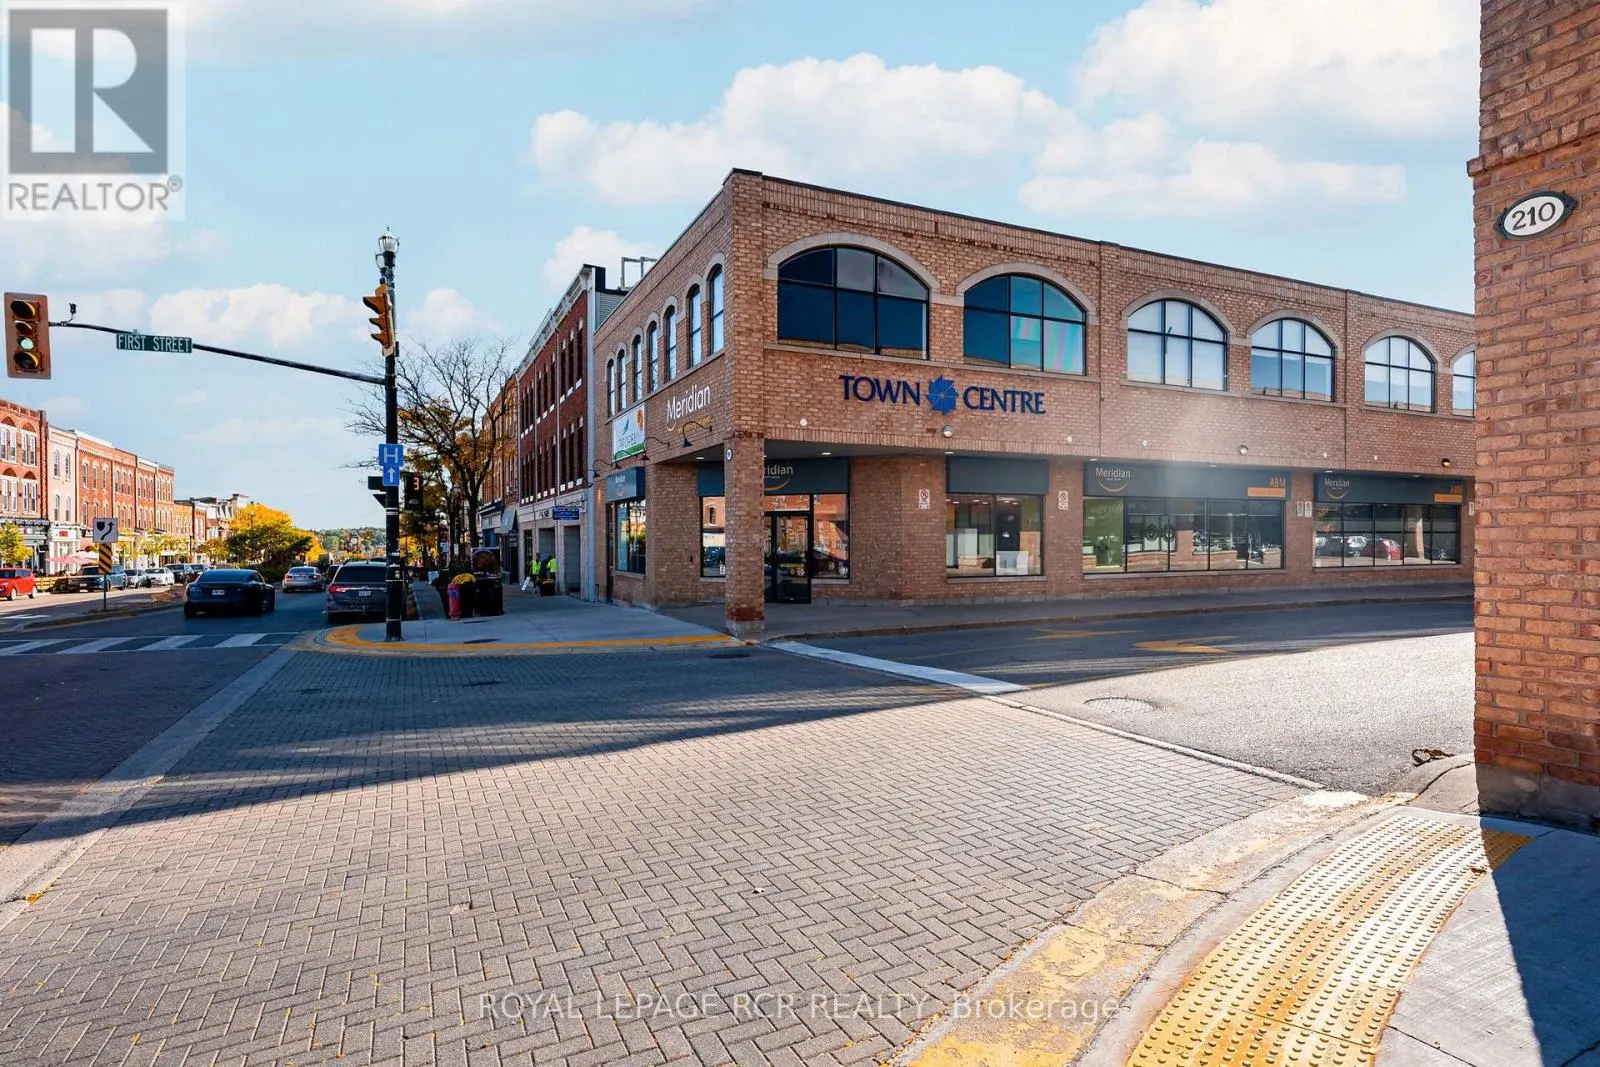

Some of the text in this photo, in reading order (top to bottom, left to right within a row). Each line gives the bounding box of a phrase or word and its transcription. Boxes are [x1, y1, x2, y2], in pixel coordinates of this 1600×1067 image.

[1511, 202, 1556, 231] 210
[118, 334, 190, 353] FIRST STREET
[666, 384, 711, 423] Meridian
[838, 374, 1046, 415] TOWN CENTRE
[383, 446, 398, 464] H
[1095, 467, 1131, 479] Meridian
